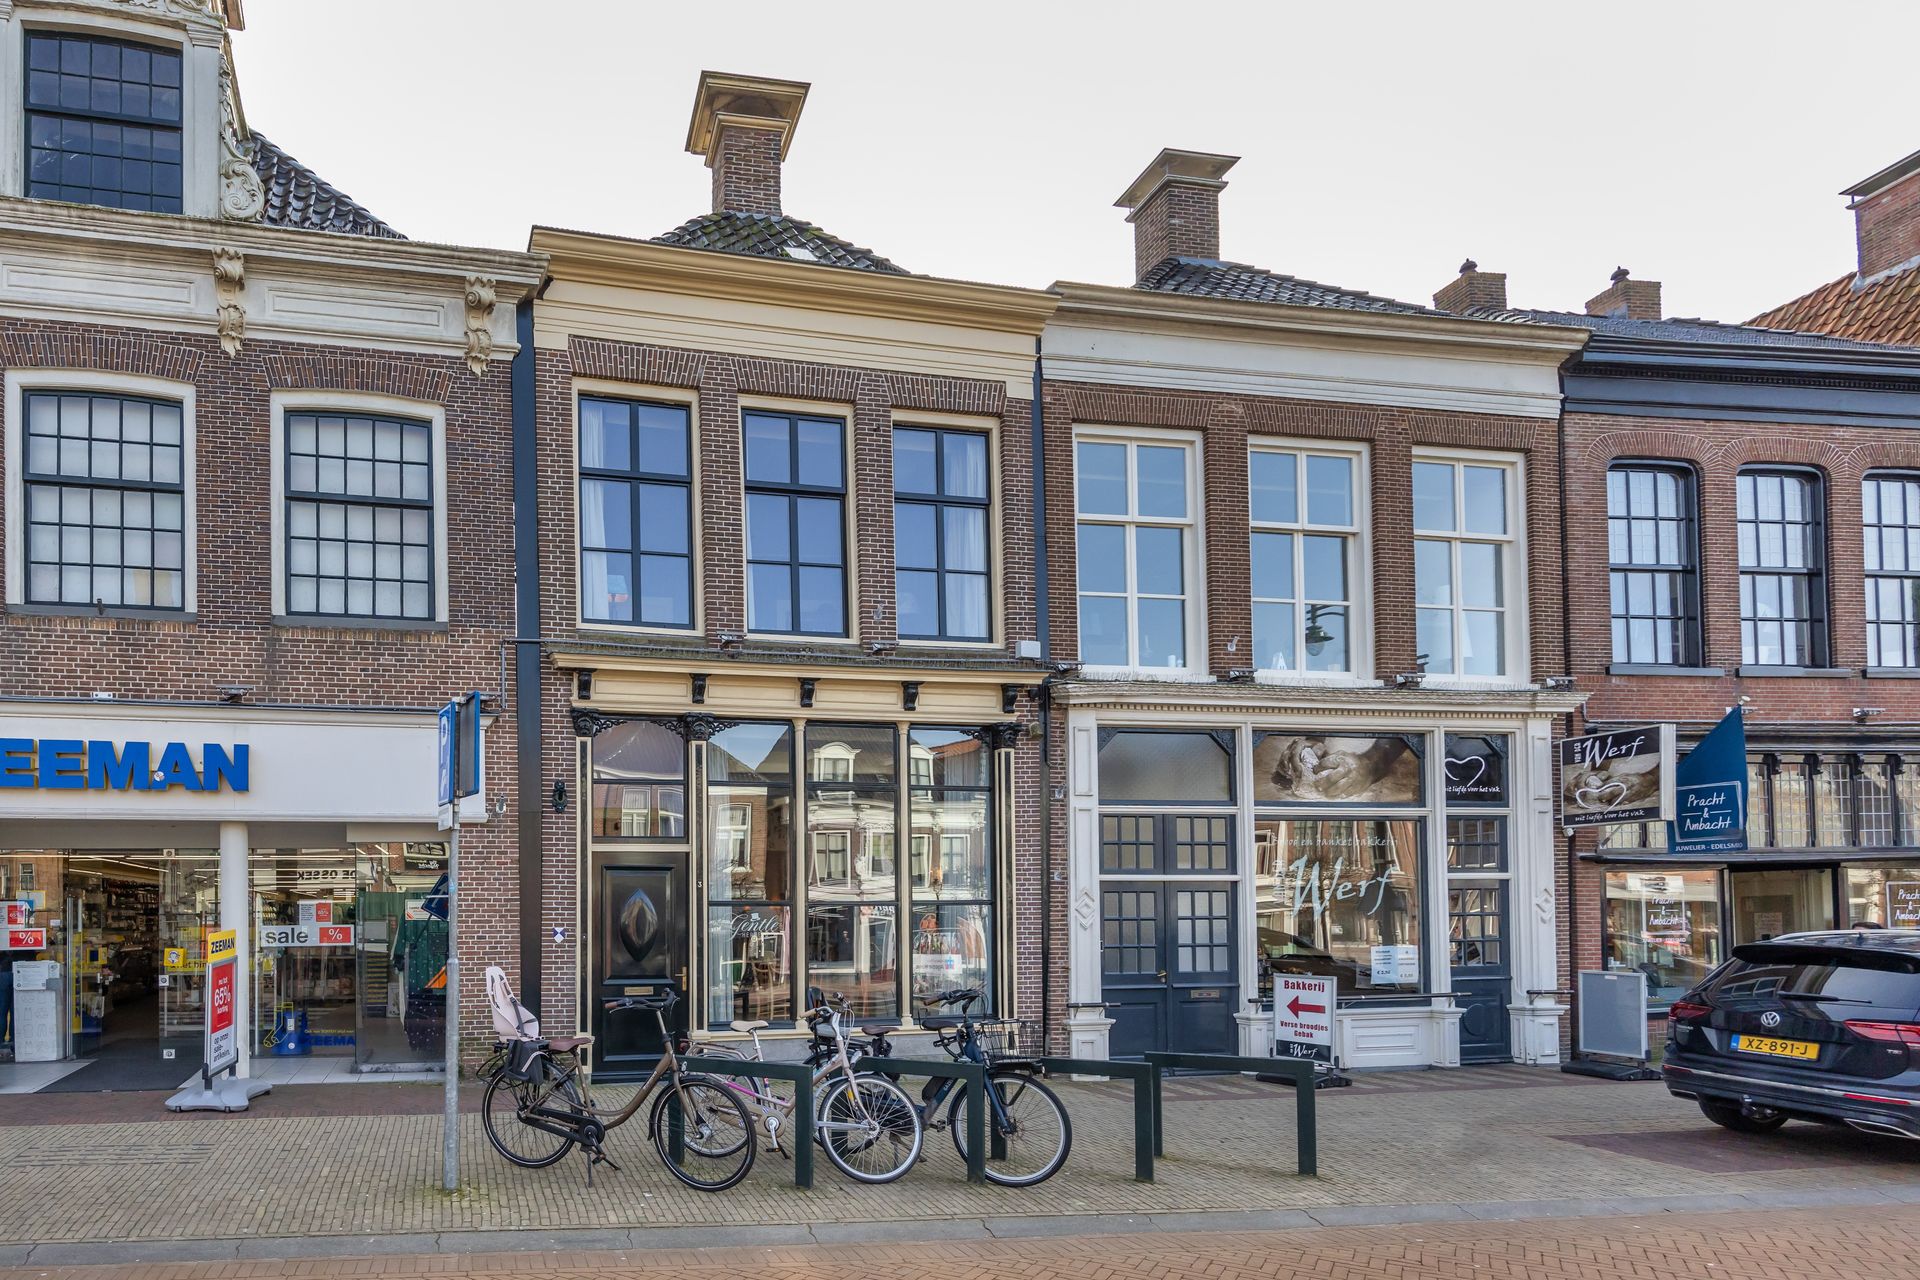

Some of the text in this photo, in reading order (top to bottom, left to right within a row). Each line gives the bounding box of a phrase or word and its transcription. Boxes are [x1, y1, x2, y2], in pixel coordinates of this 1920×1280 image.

[1582, 735, 1645, 769] Werf
[0, 738, 249, 792] EEMAN
[1687, 792, 1727, 807] Pracht
[1618, 810, 1629, 818] het
[1703, 807, 1710, 818] &
[1684, 815, 1732, 831] Ambacht
[1675, 844, 1706, 852] JUWELIER
[1711, 842, 1743, 850] EDELSMID
[1289, 854, 1398, 921] Werf
[728, 912, 779, 941] Gentle
[265, 927, 343, 944] sale %
[211, 937, 235, 954] ZEEMAN
[1284, 980, 1325, 992] Bakkerij
[214, 984, 232, 1007] 65%
[1280, 1020, 1329, 1032] Verse broodjes
[1294, 1030, 1313, 1038] Gebak
[1293, 1043, 1318, 1058] Werf
[1745, 1038, 1808, 1055] XZ-891-J
